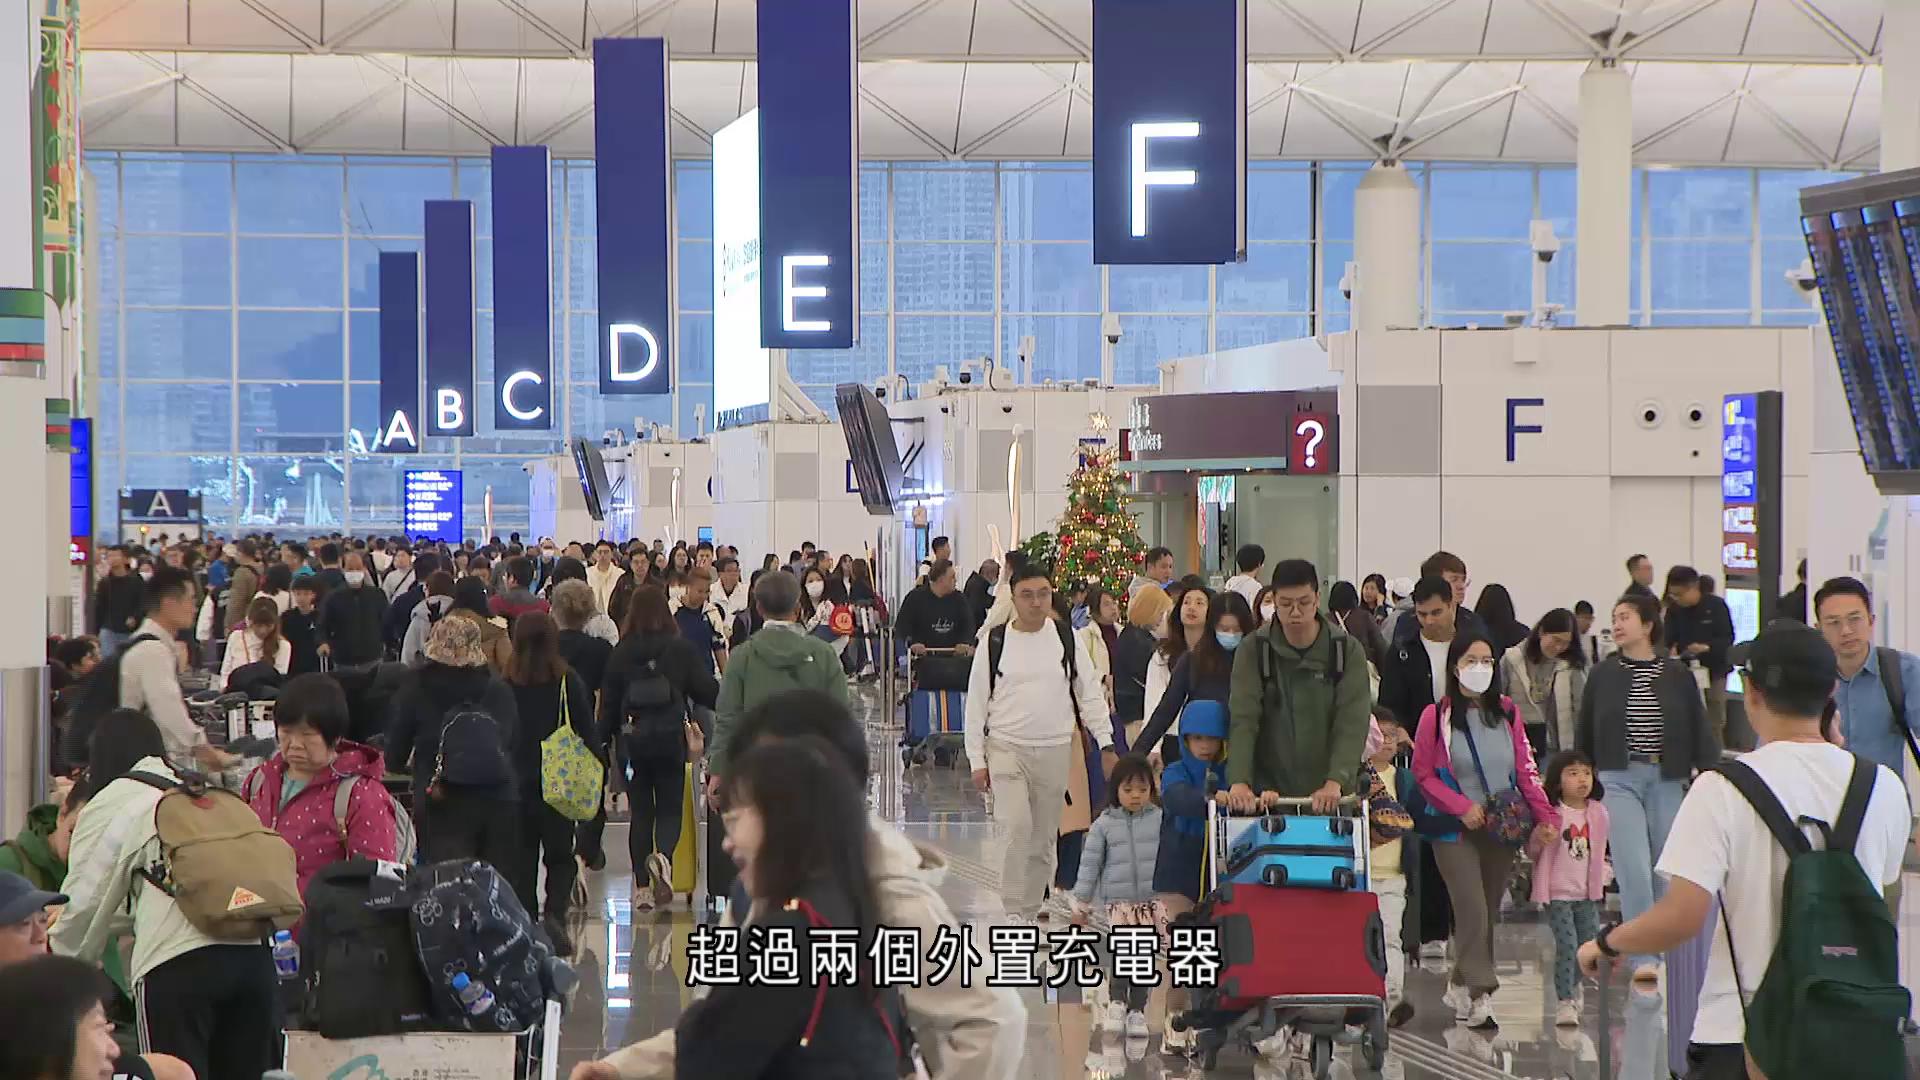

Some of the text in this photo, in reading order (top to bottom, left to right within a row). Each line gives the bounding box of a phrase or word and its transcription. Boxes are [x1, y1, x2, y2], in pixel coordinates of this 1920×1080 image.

[1129, 121, 1200, 237] F
[782, 255, 832, 331] E
[609, 324, 658, 382] D
[437, 390, 464, 429] B
[502, 372, 543, 419] C
[383, 410, 416, 447] A
[1506, 399, 1543, 461] F
[147, 490, 173, 517] A
